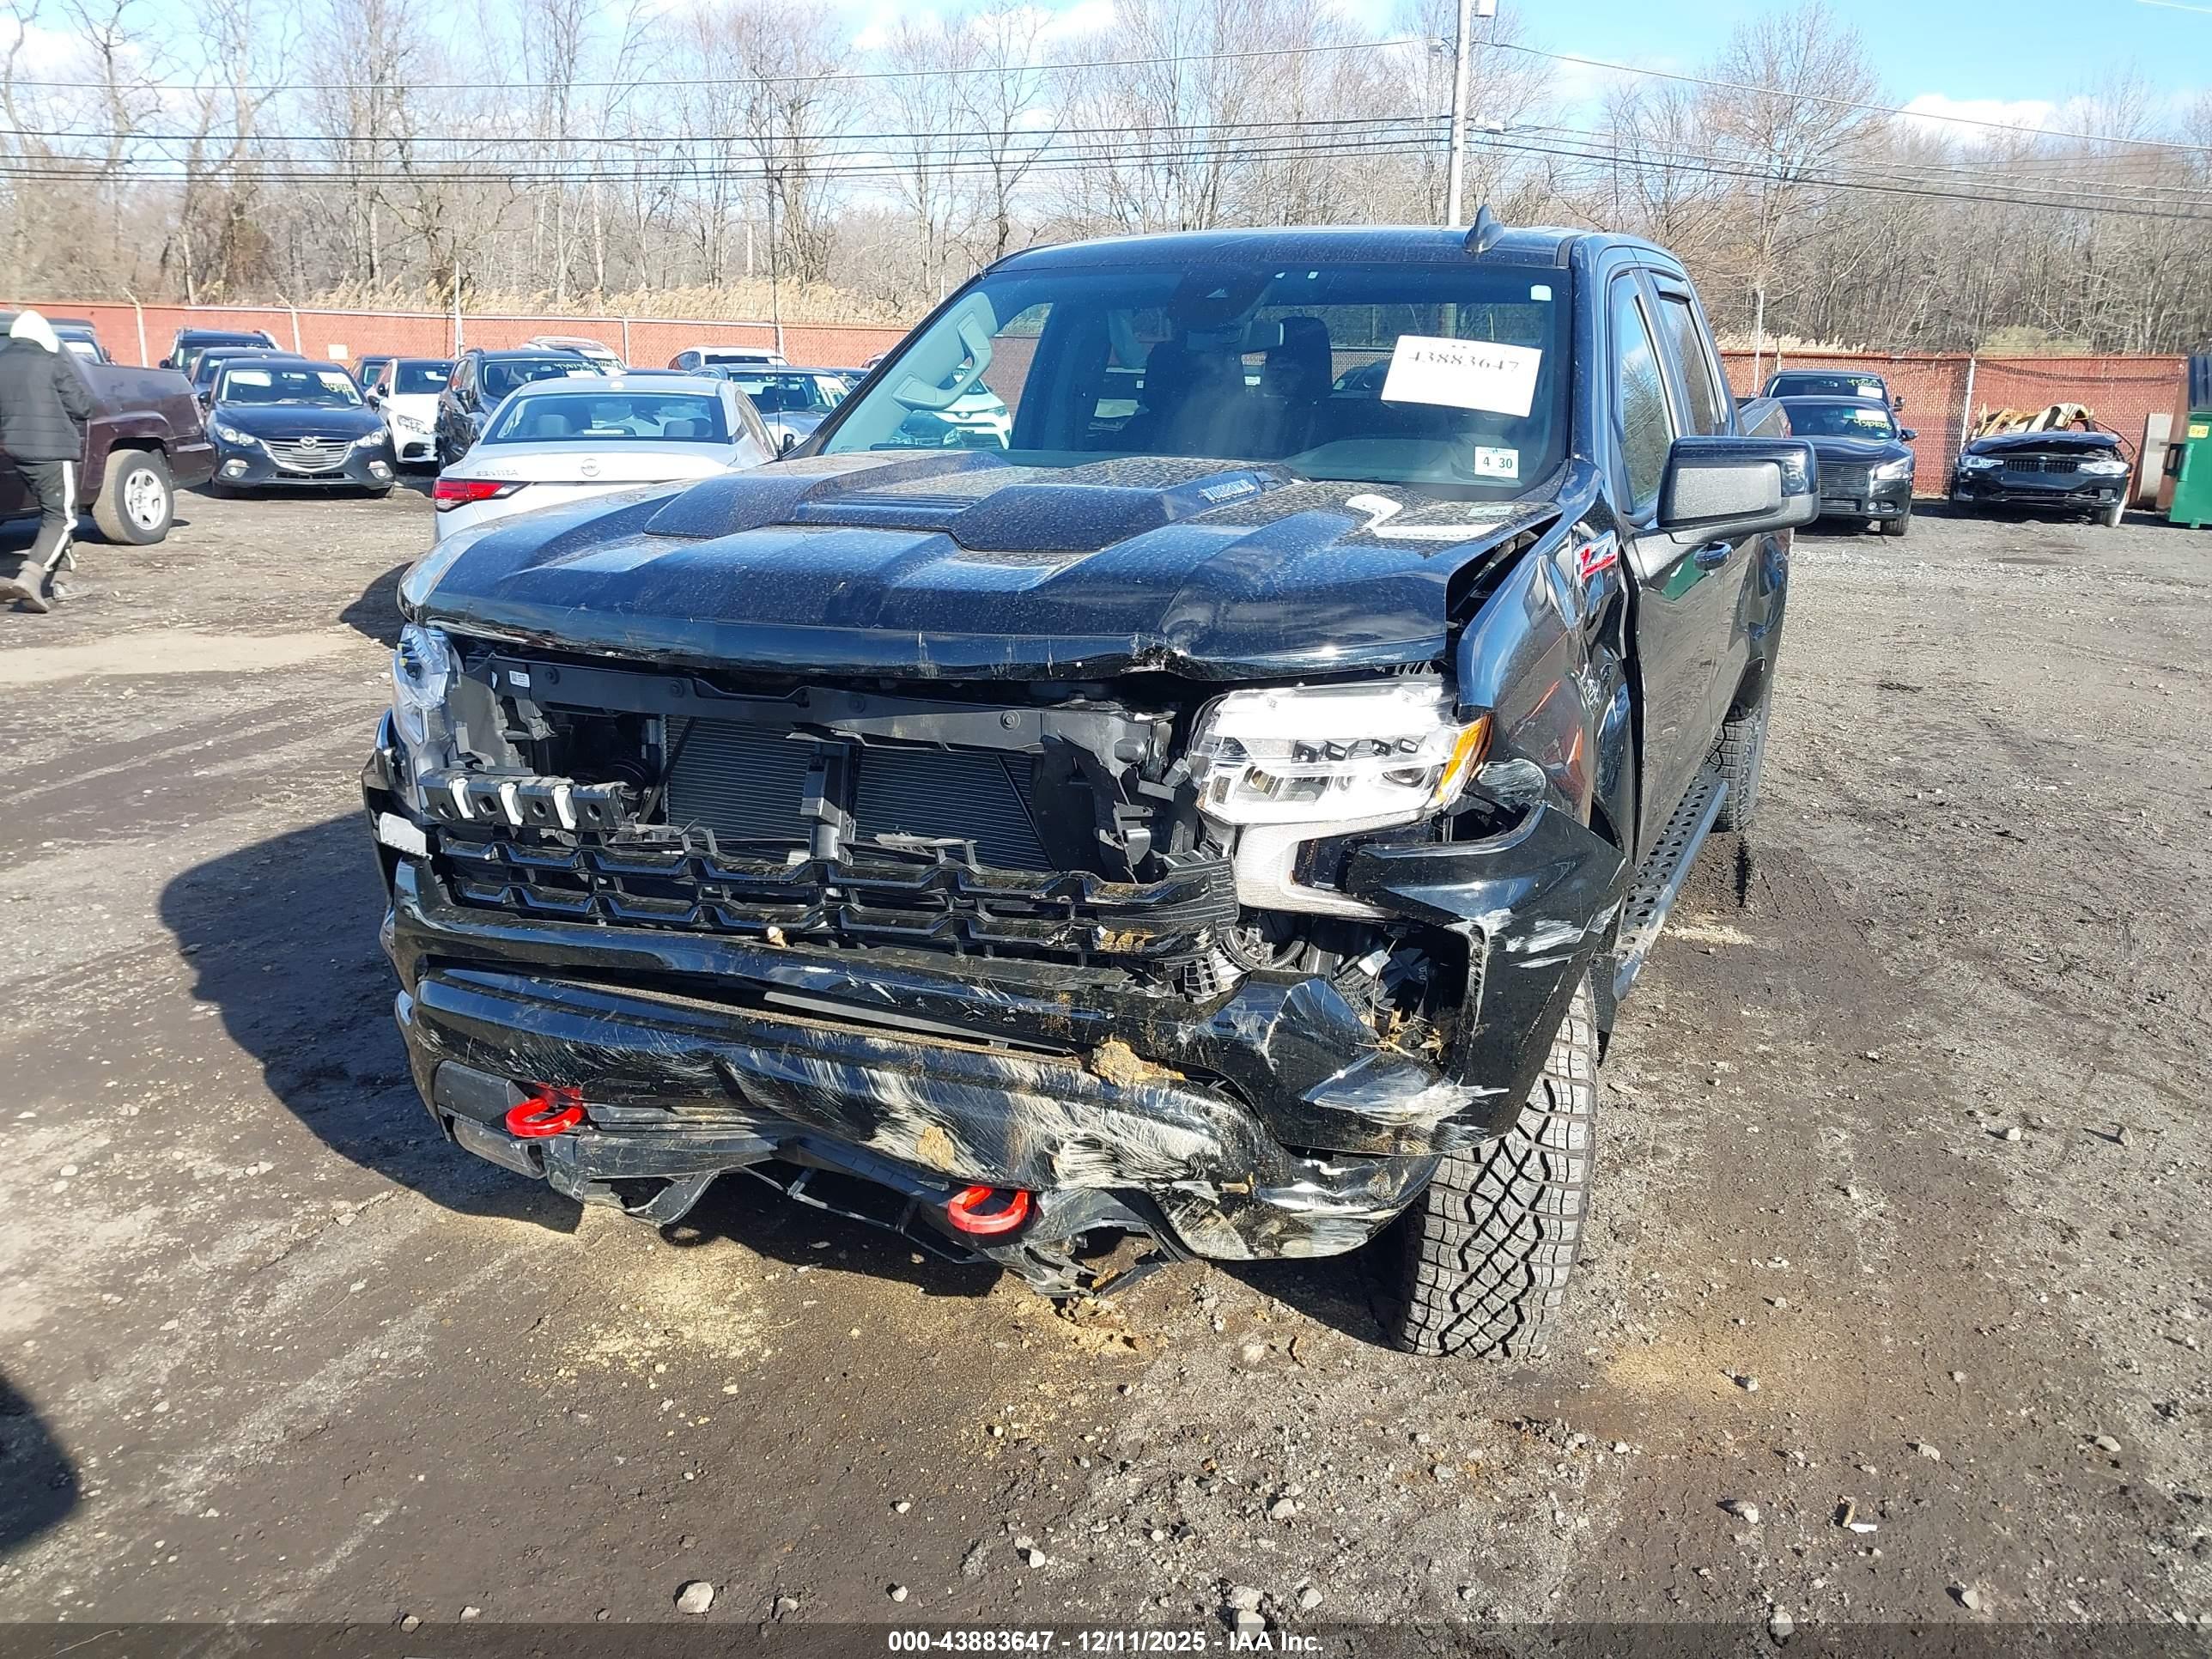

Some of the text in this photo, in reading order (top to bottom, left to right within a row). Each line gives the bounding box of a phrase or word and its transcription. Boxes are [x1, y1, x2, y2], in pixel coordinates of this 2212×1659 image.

[1408, 350, 1519, 372] 43883647
[1483, 456, 1513, 469] 4 30
